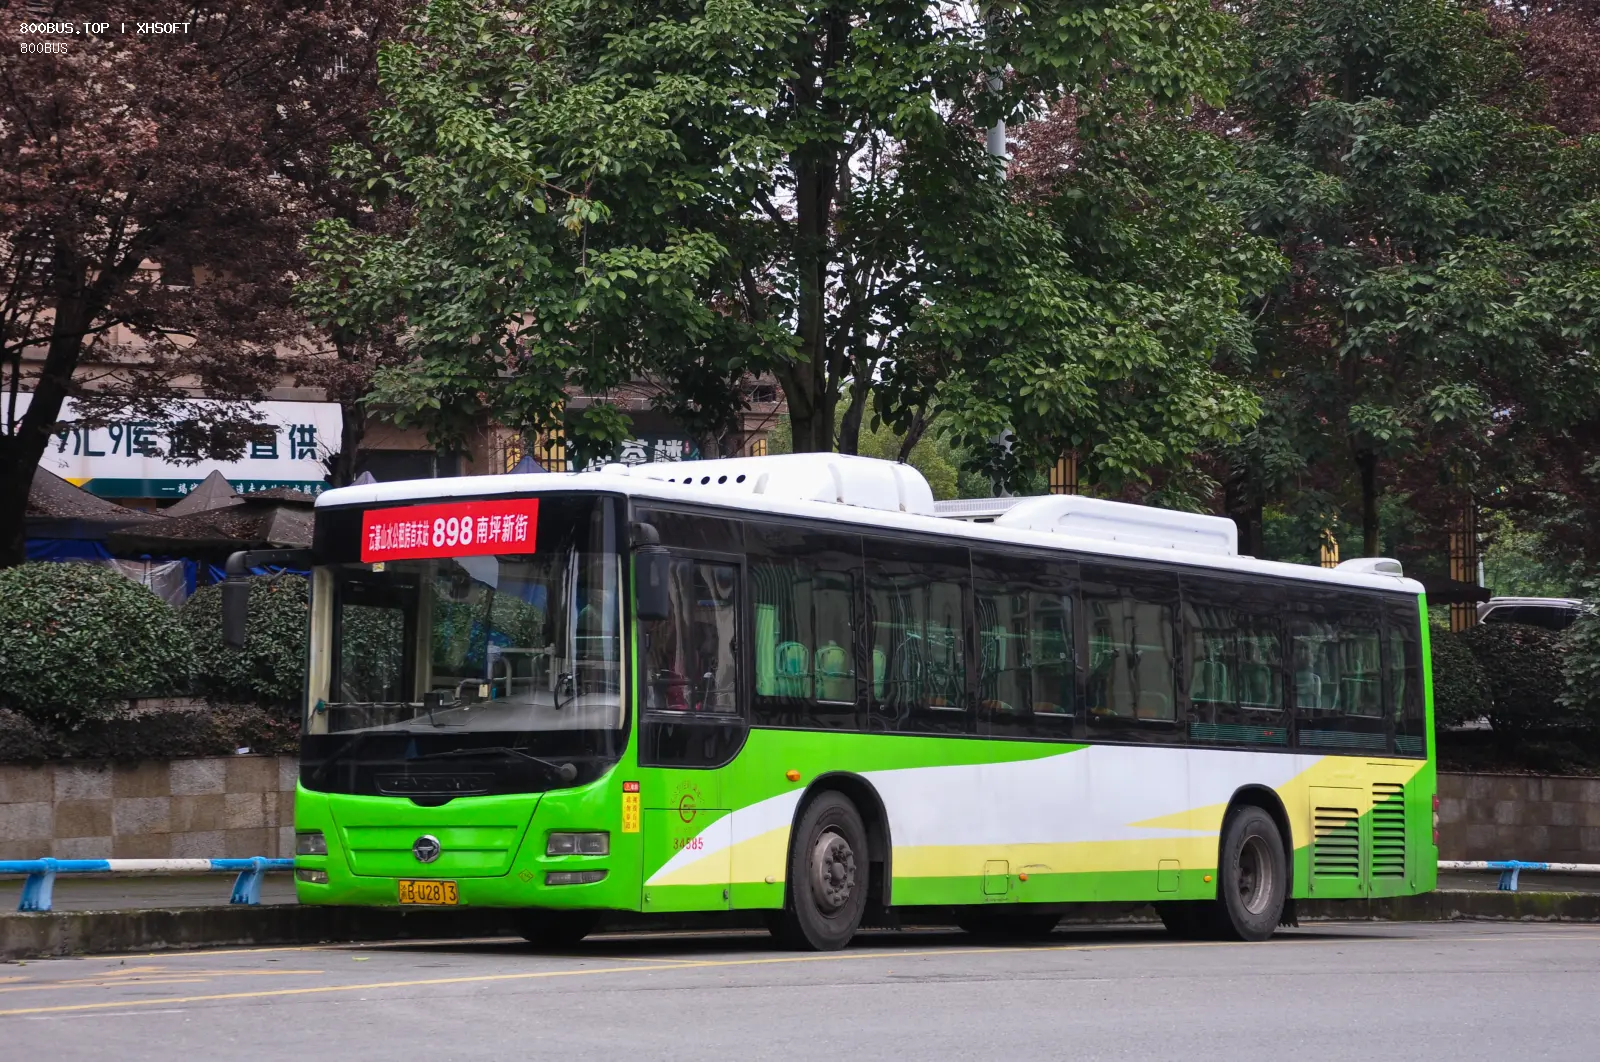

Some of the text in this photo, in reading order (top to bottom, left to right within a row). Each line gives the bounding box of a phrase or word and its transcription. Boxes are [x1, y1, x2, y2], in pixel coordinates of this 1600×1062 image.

[432, 516, 473, 548] 898
[476, 513, 529, 544] 南坪新街
[673, 837, 704, 850] 34585
